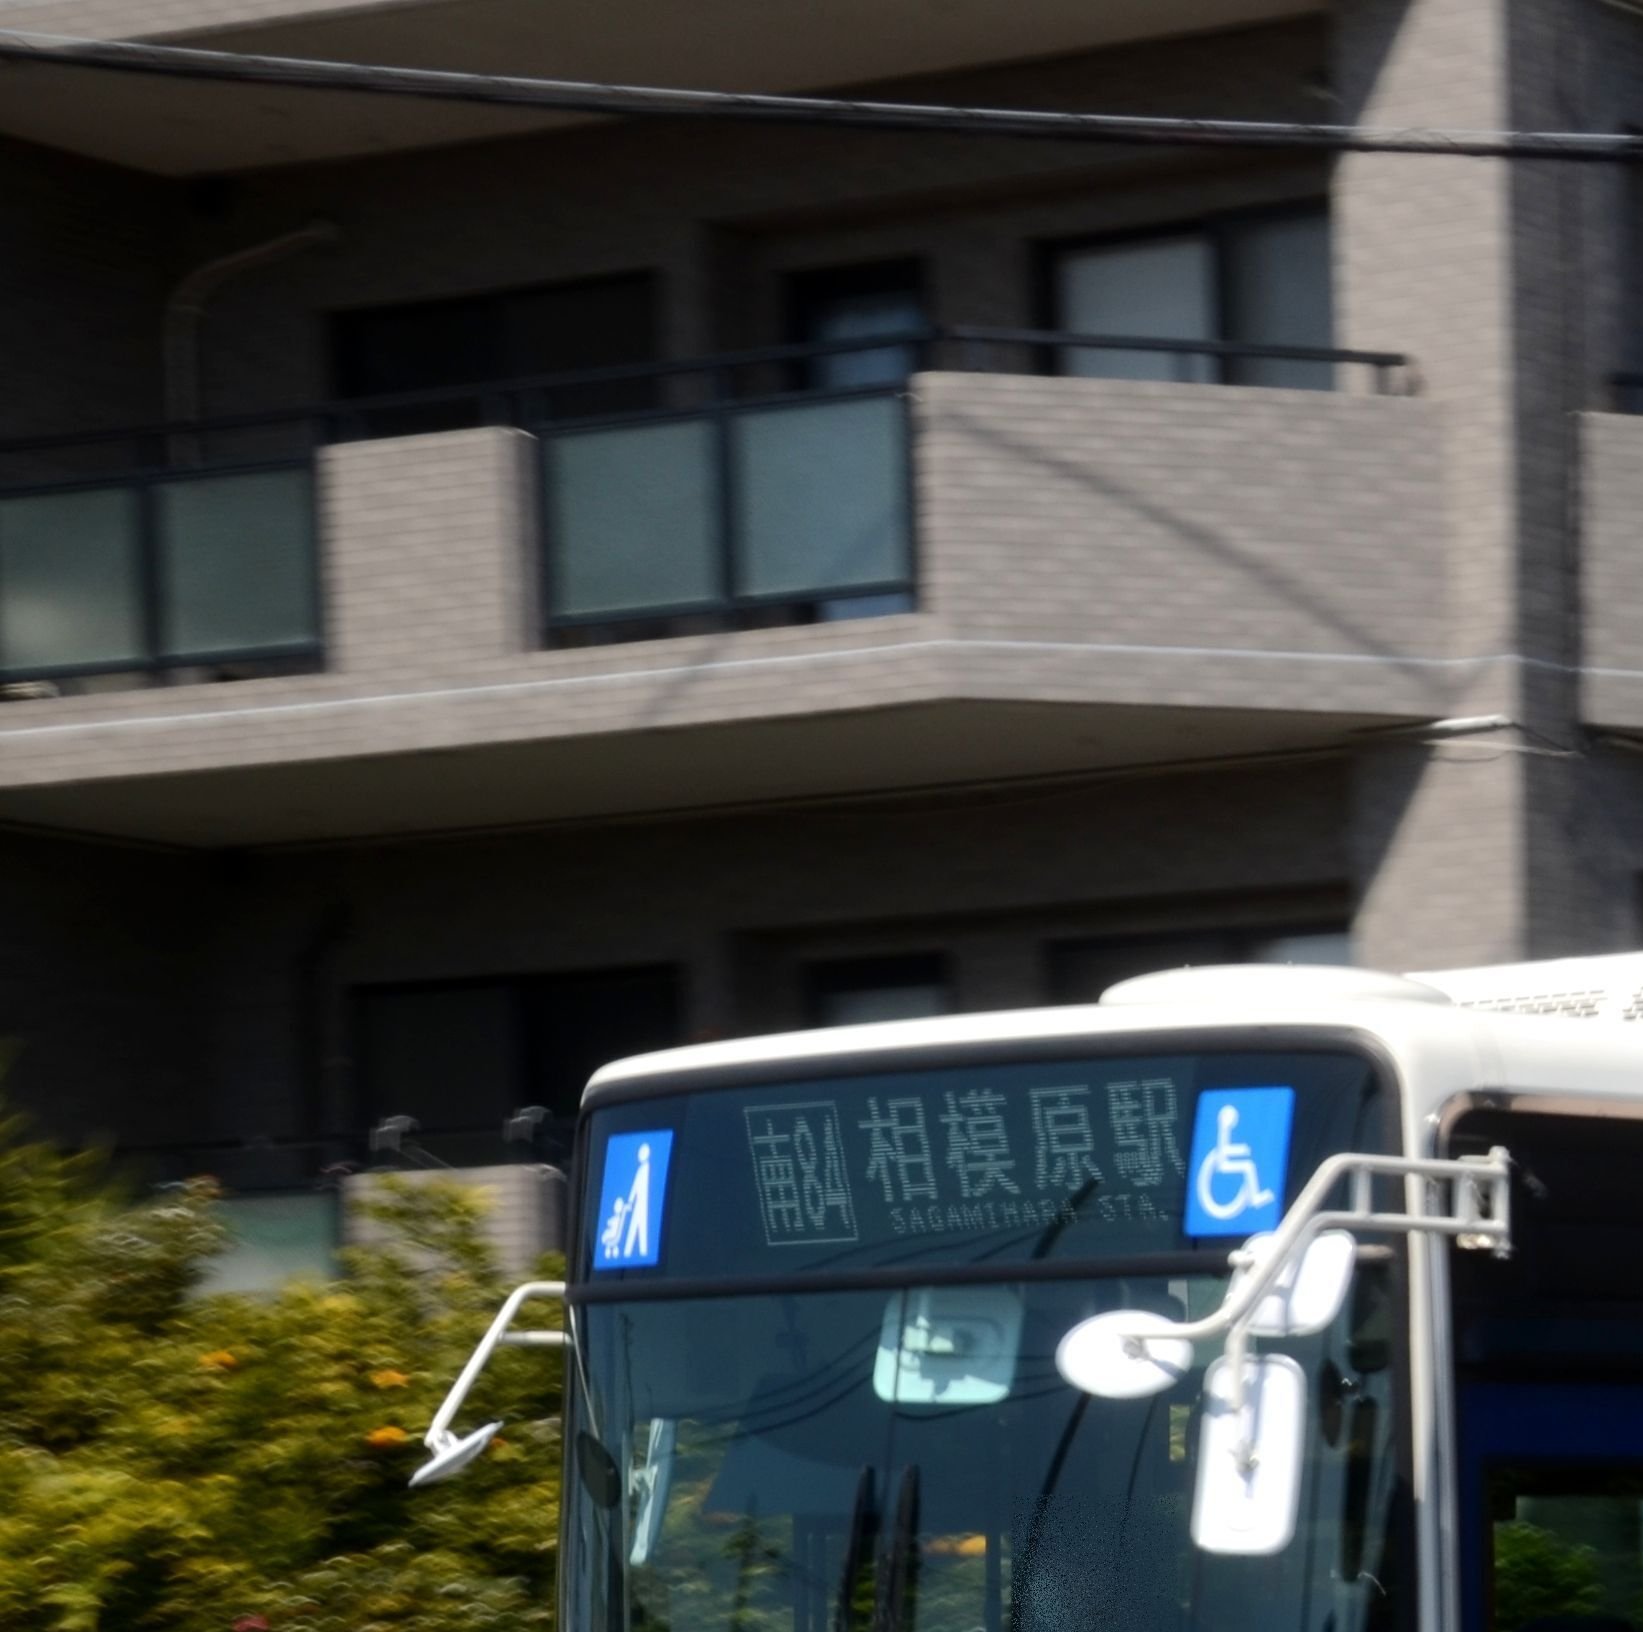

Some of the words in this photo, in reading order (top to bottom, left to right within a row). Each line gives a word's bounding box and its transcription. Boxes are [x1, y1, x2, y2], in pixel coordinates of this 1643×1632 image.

[858, 1077, 1185, 1202] 相模原駅
[890, 1199, 1078, 1235] SAGAMIHARA
